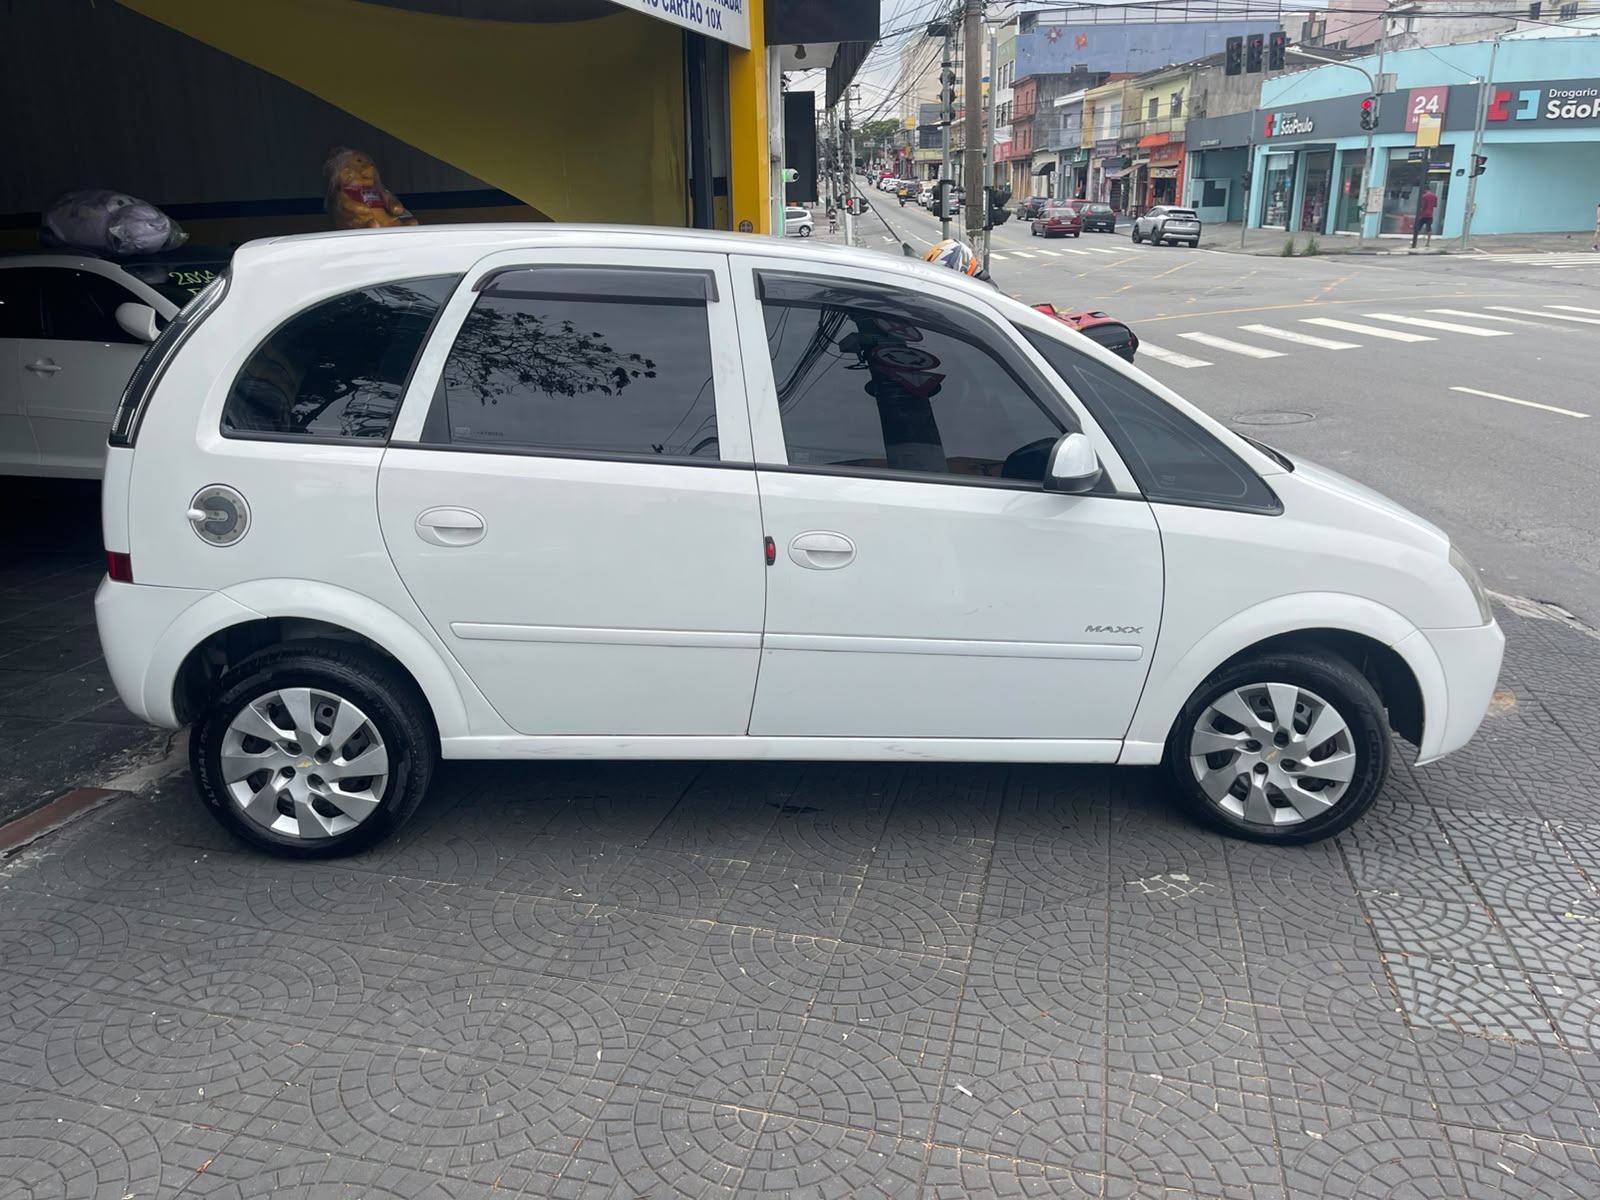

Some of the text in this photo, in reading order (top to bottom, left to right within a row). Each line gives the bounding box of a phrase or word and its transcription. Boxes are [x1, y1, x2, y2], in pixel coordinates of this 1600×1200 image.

[706, 6, 722, 30] 10X
[1549, 88, 1598, 99] Drogaria
[1413, 95, 1439, 114] 24
[1084, 625, 1144, 634] MAXX
